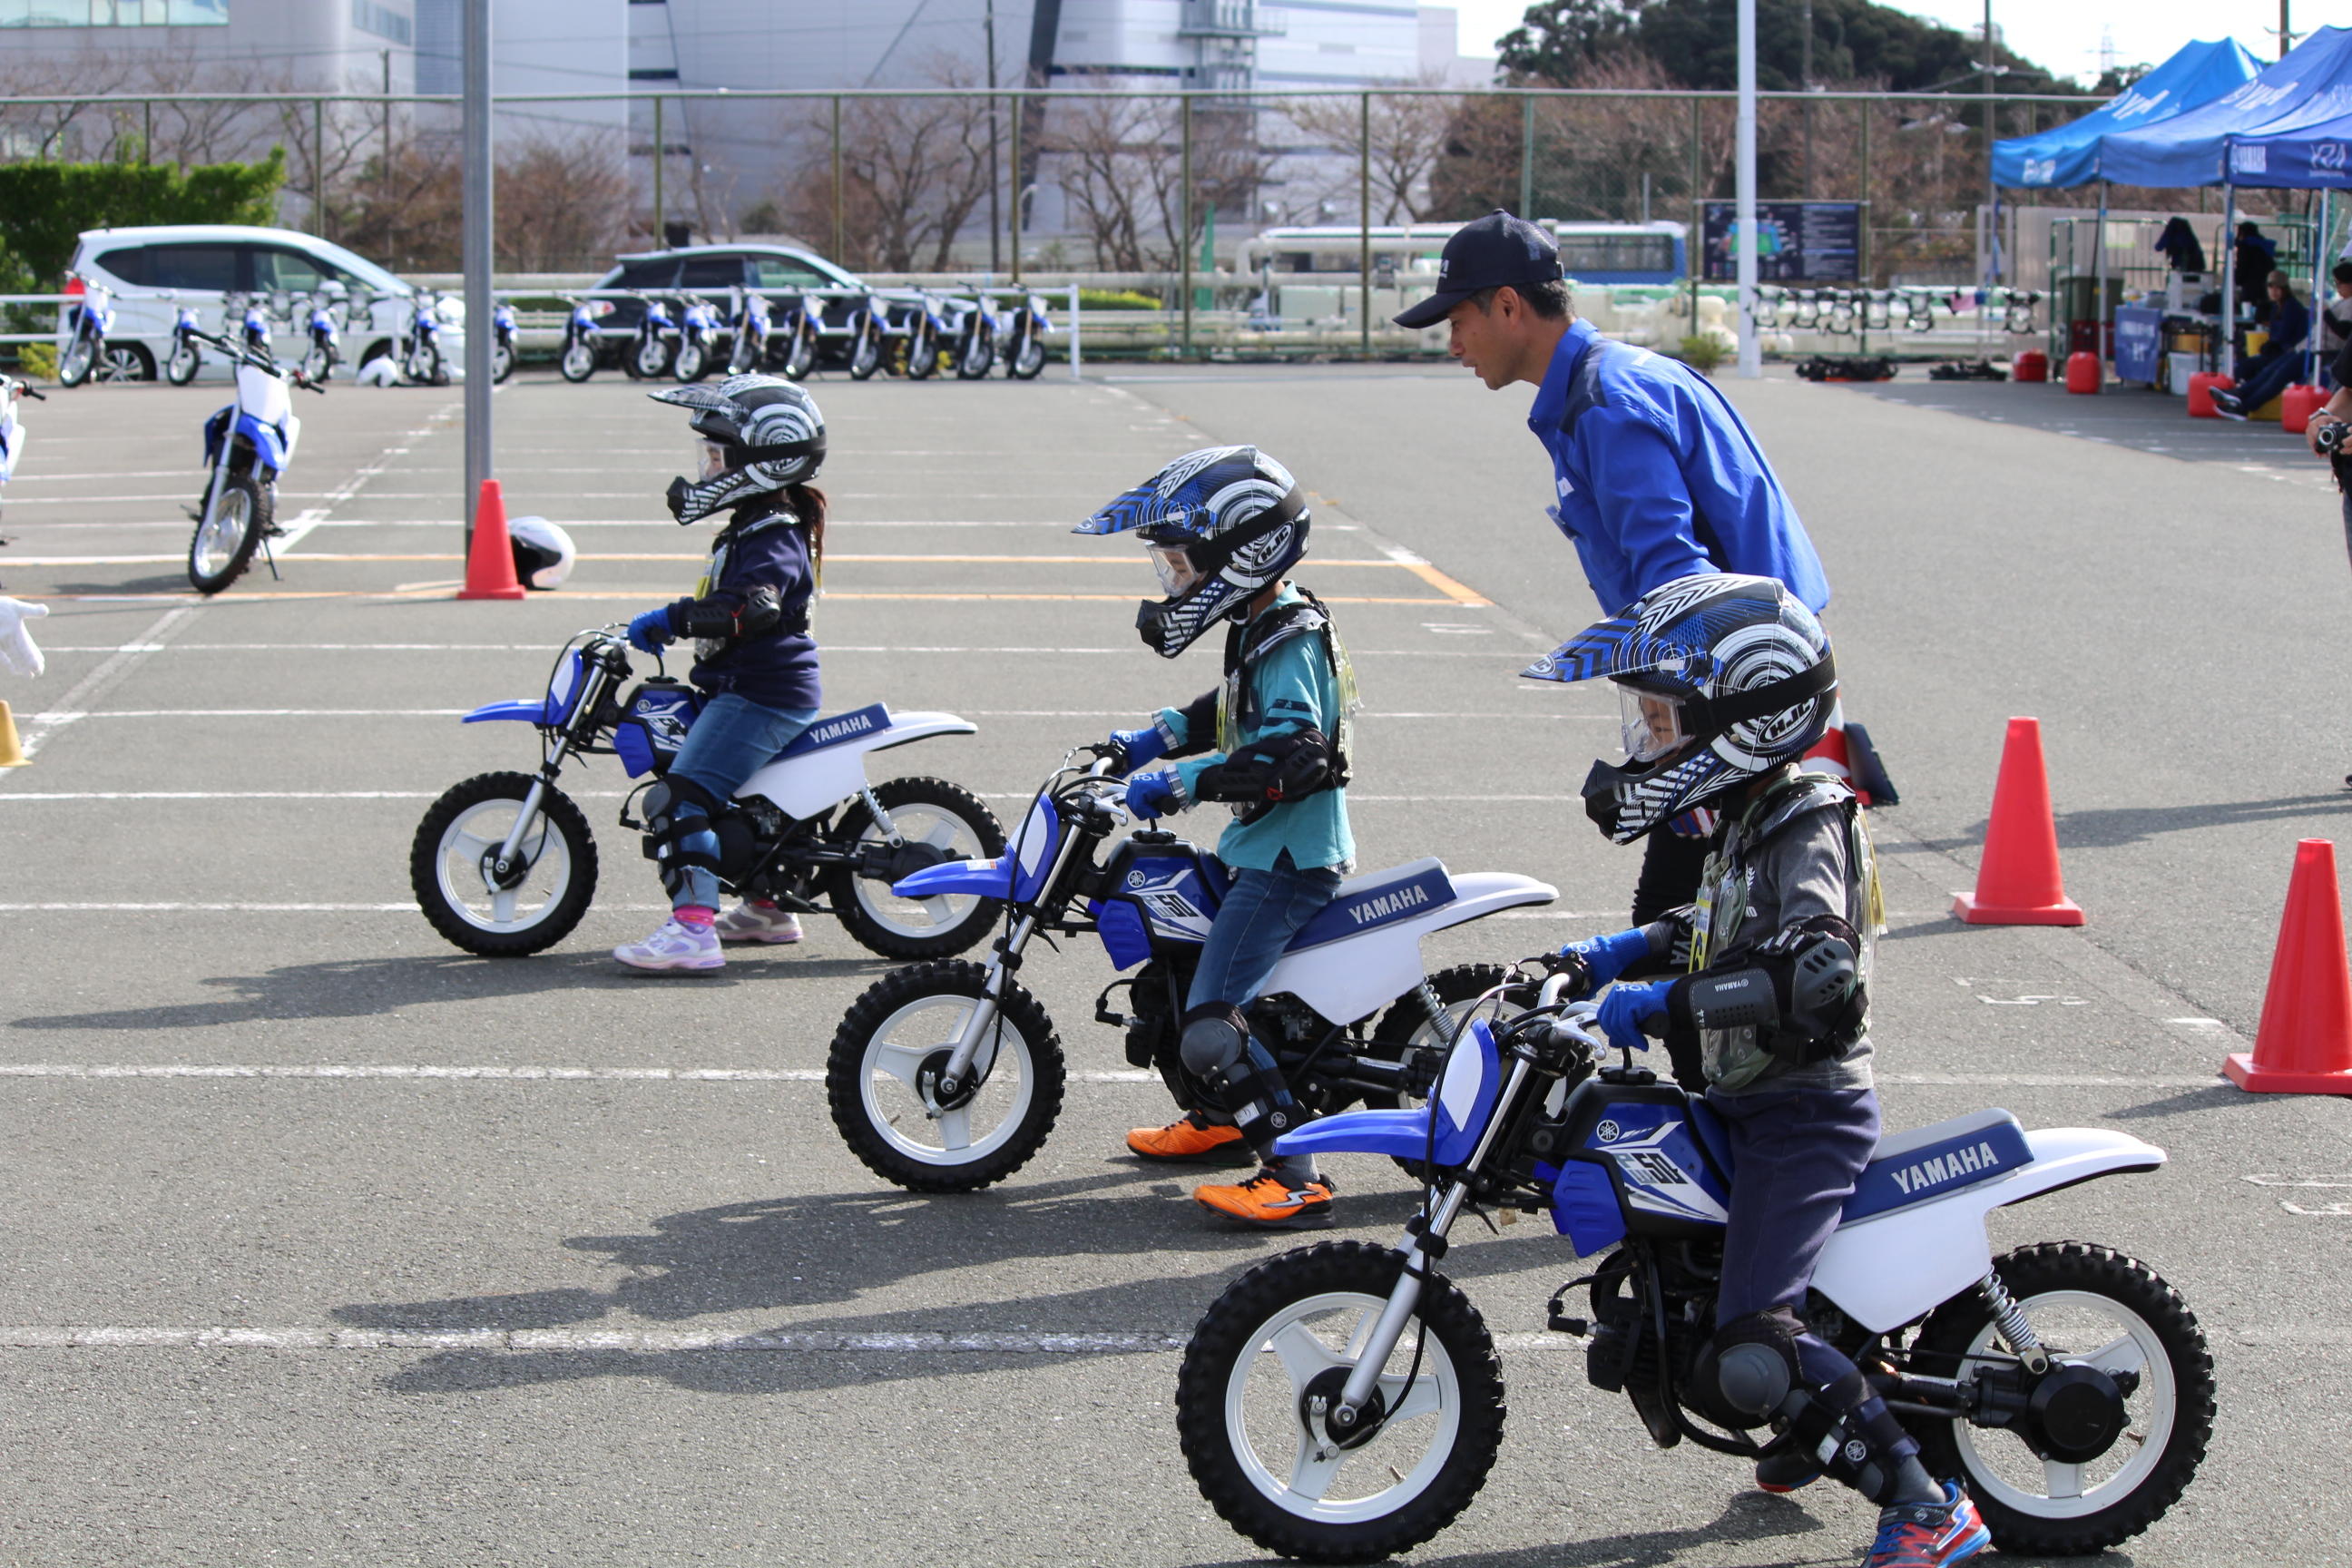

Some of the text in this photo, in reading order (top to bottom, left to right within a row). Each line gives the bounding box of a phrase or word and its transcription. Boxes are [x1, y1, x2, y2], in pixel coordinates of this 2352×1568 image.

[1260, 526, 1289, 562] HJC
[809, 714, 872, 743] YAMAHA
[1348, 885, 1429, 924] YAMAHA
[1714, 981, 1741, 993] YAMAHA
[1890, 1142, 1999, 1194] YAMAHA
